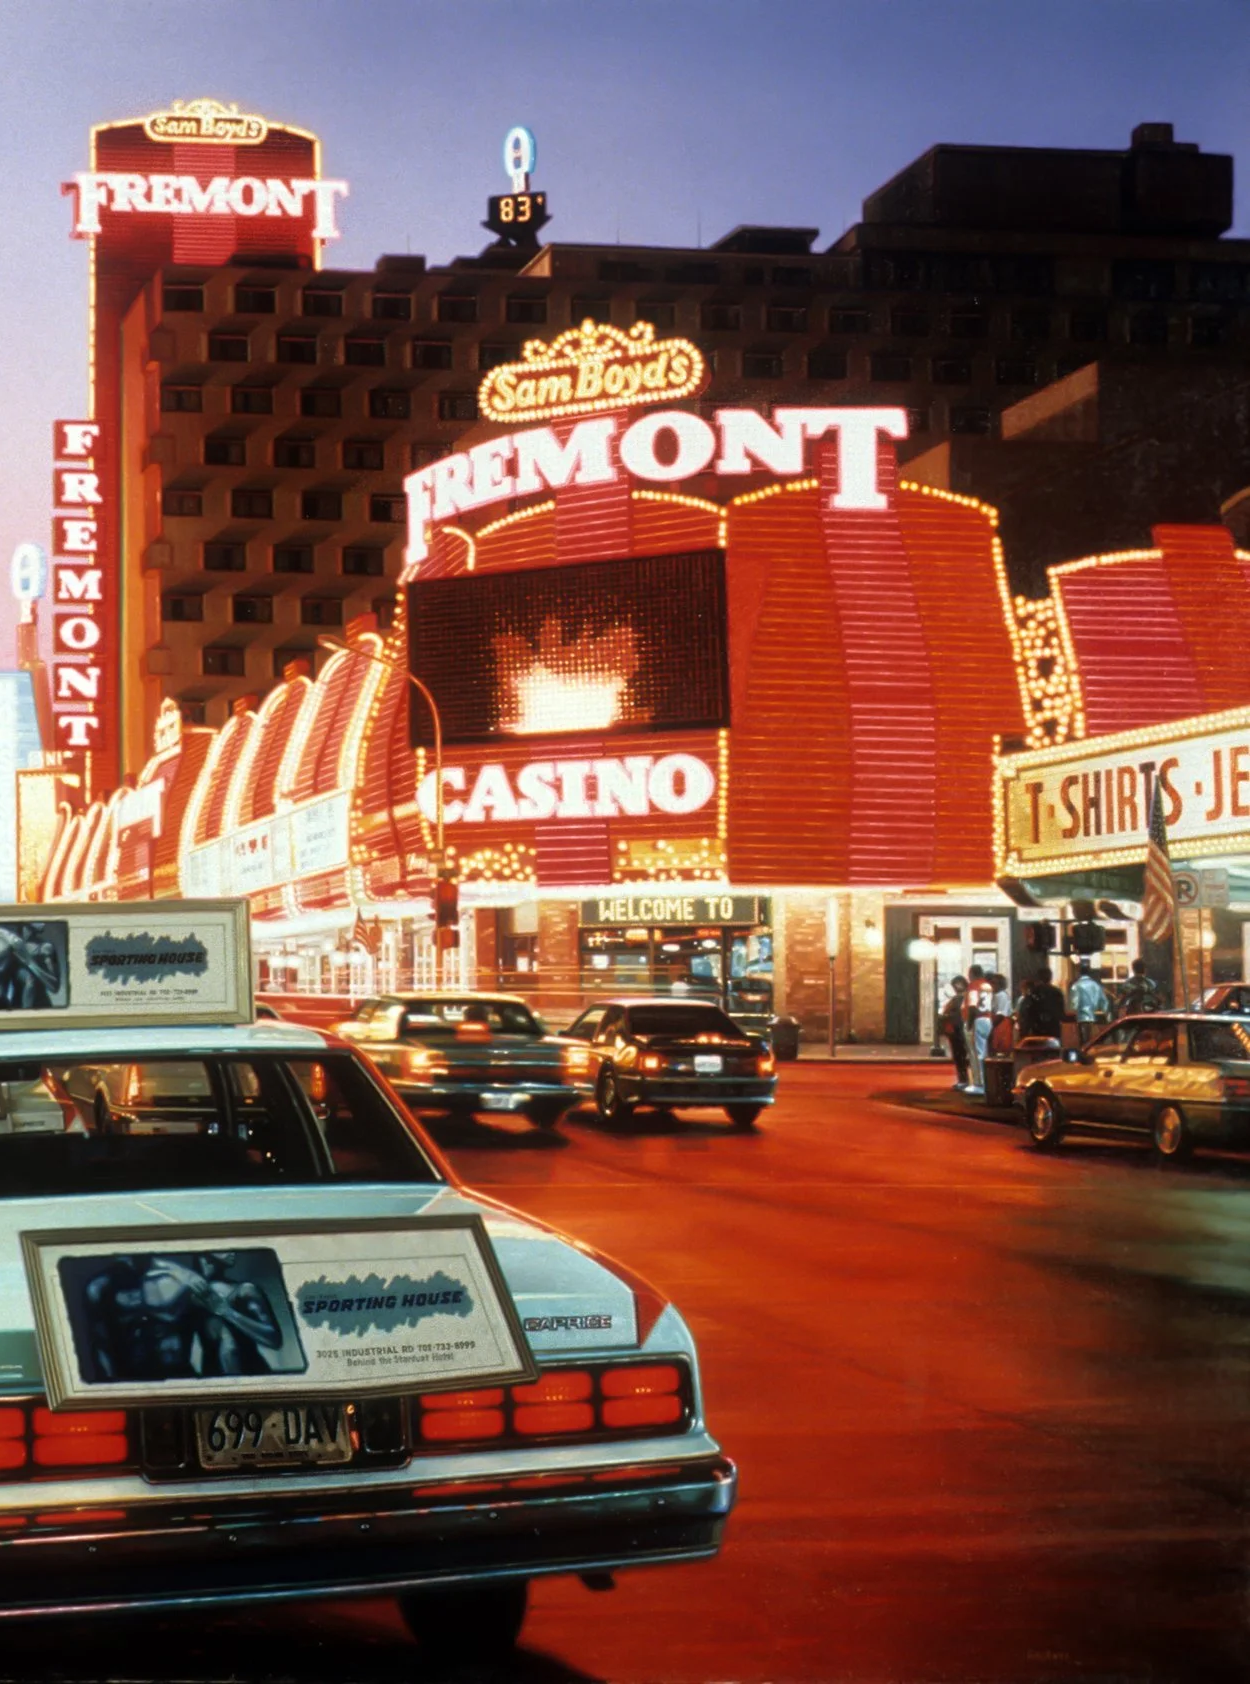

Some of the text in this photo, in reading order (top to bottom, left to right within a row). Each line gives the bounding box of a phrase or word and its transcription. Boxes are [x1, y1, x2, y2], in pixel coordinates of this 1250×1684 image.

[154, 116, 197, 136] Sam
[74, 172, 348, 239] FREMONT
[492, 350, 689, 413] Sam Boyd's
[402, 406, 909, 566] FREMONT
[57, 423, 102, 747] FREMONT
[414, 752, 716, 825] CASINO
[598, 896, 735, 922] WELCOME TO
[89, 951, 206, 966] SPORTING HOUSE
[302, 1290, 464, 1314] SPORTING HOUSE
[523, 1314, 612, 1332] CAPRICE
[342, 1345, 399, 1357] INDUSTRIAL
[402, 1344, 415, 1354] RD
[207, 1408, 263, 1451] 699
